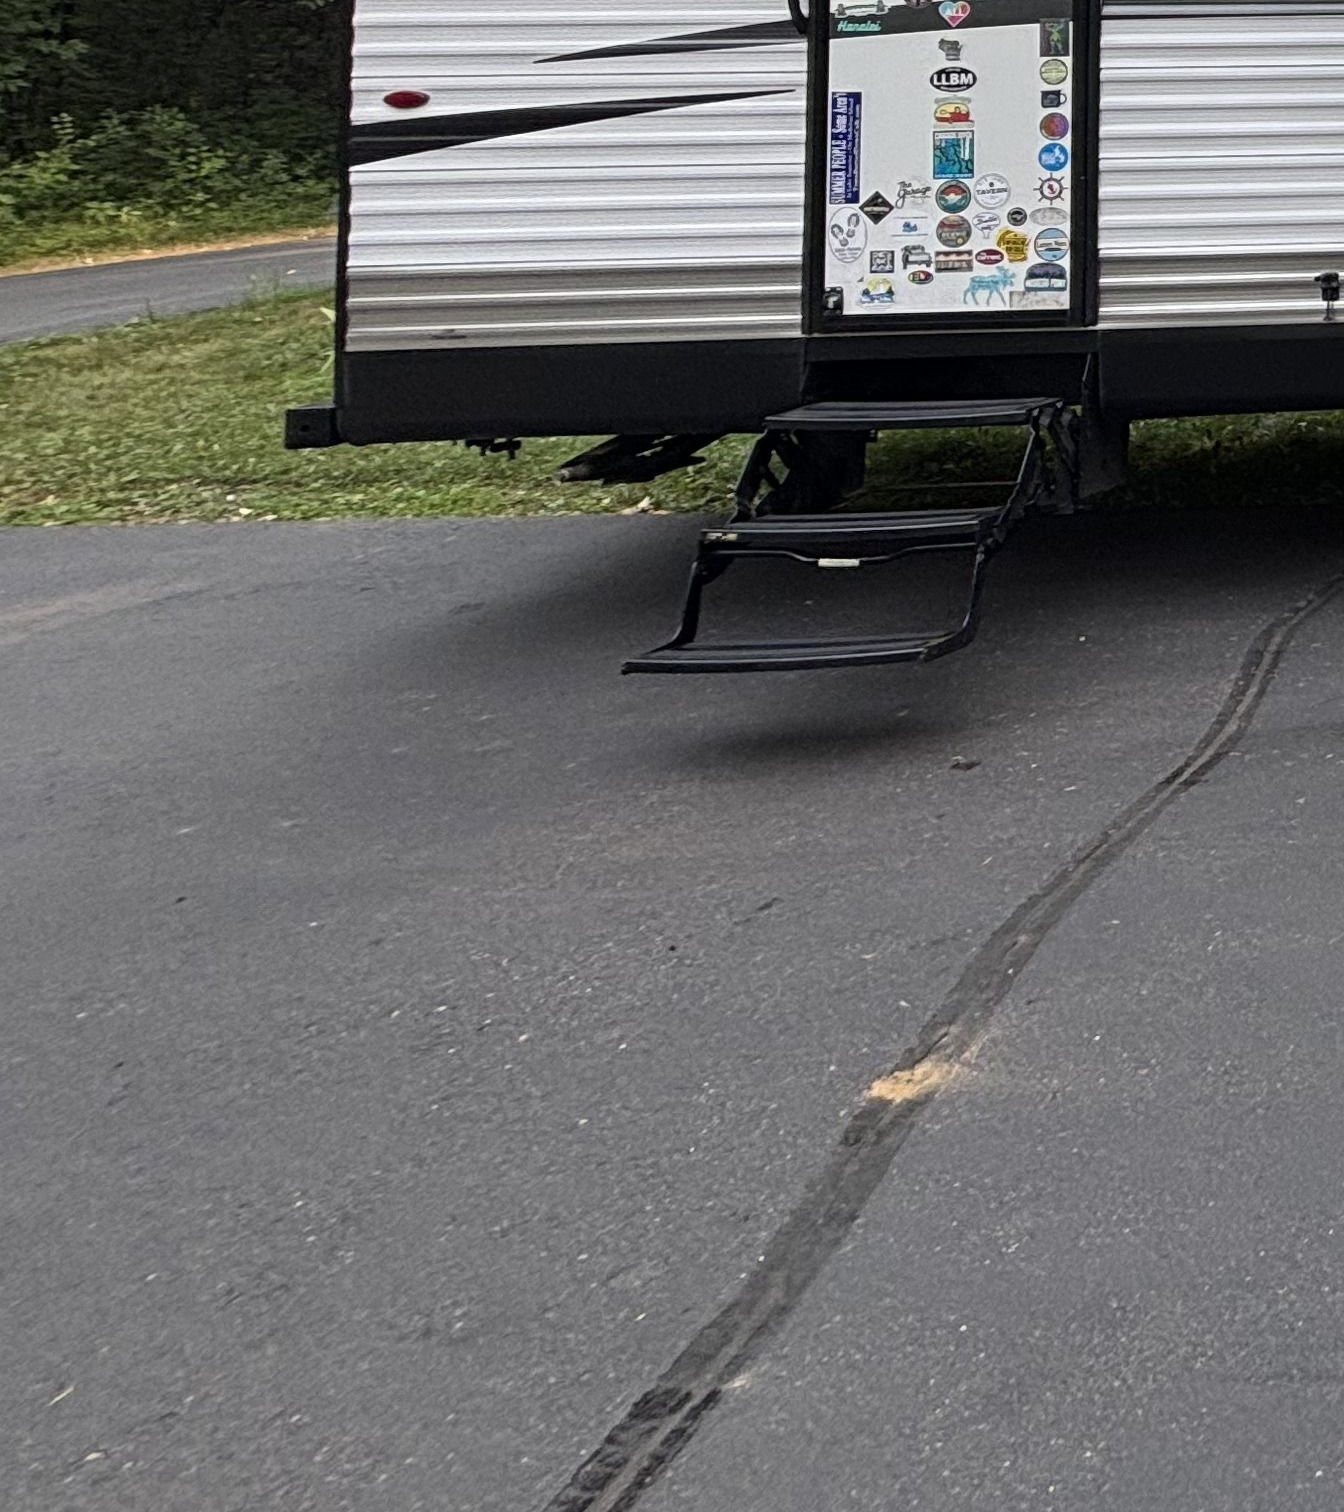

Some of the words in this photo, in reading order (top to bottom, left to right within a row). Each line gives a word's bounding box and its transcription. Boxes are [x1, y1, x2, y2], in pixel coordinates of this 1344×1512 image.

[933, 73, 974, 85] LLBM
[831, 139, 846, 169] PEOPLE
[831, 171, 846, 204] SUMMER
